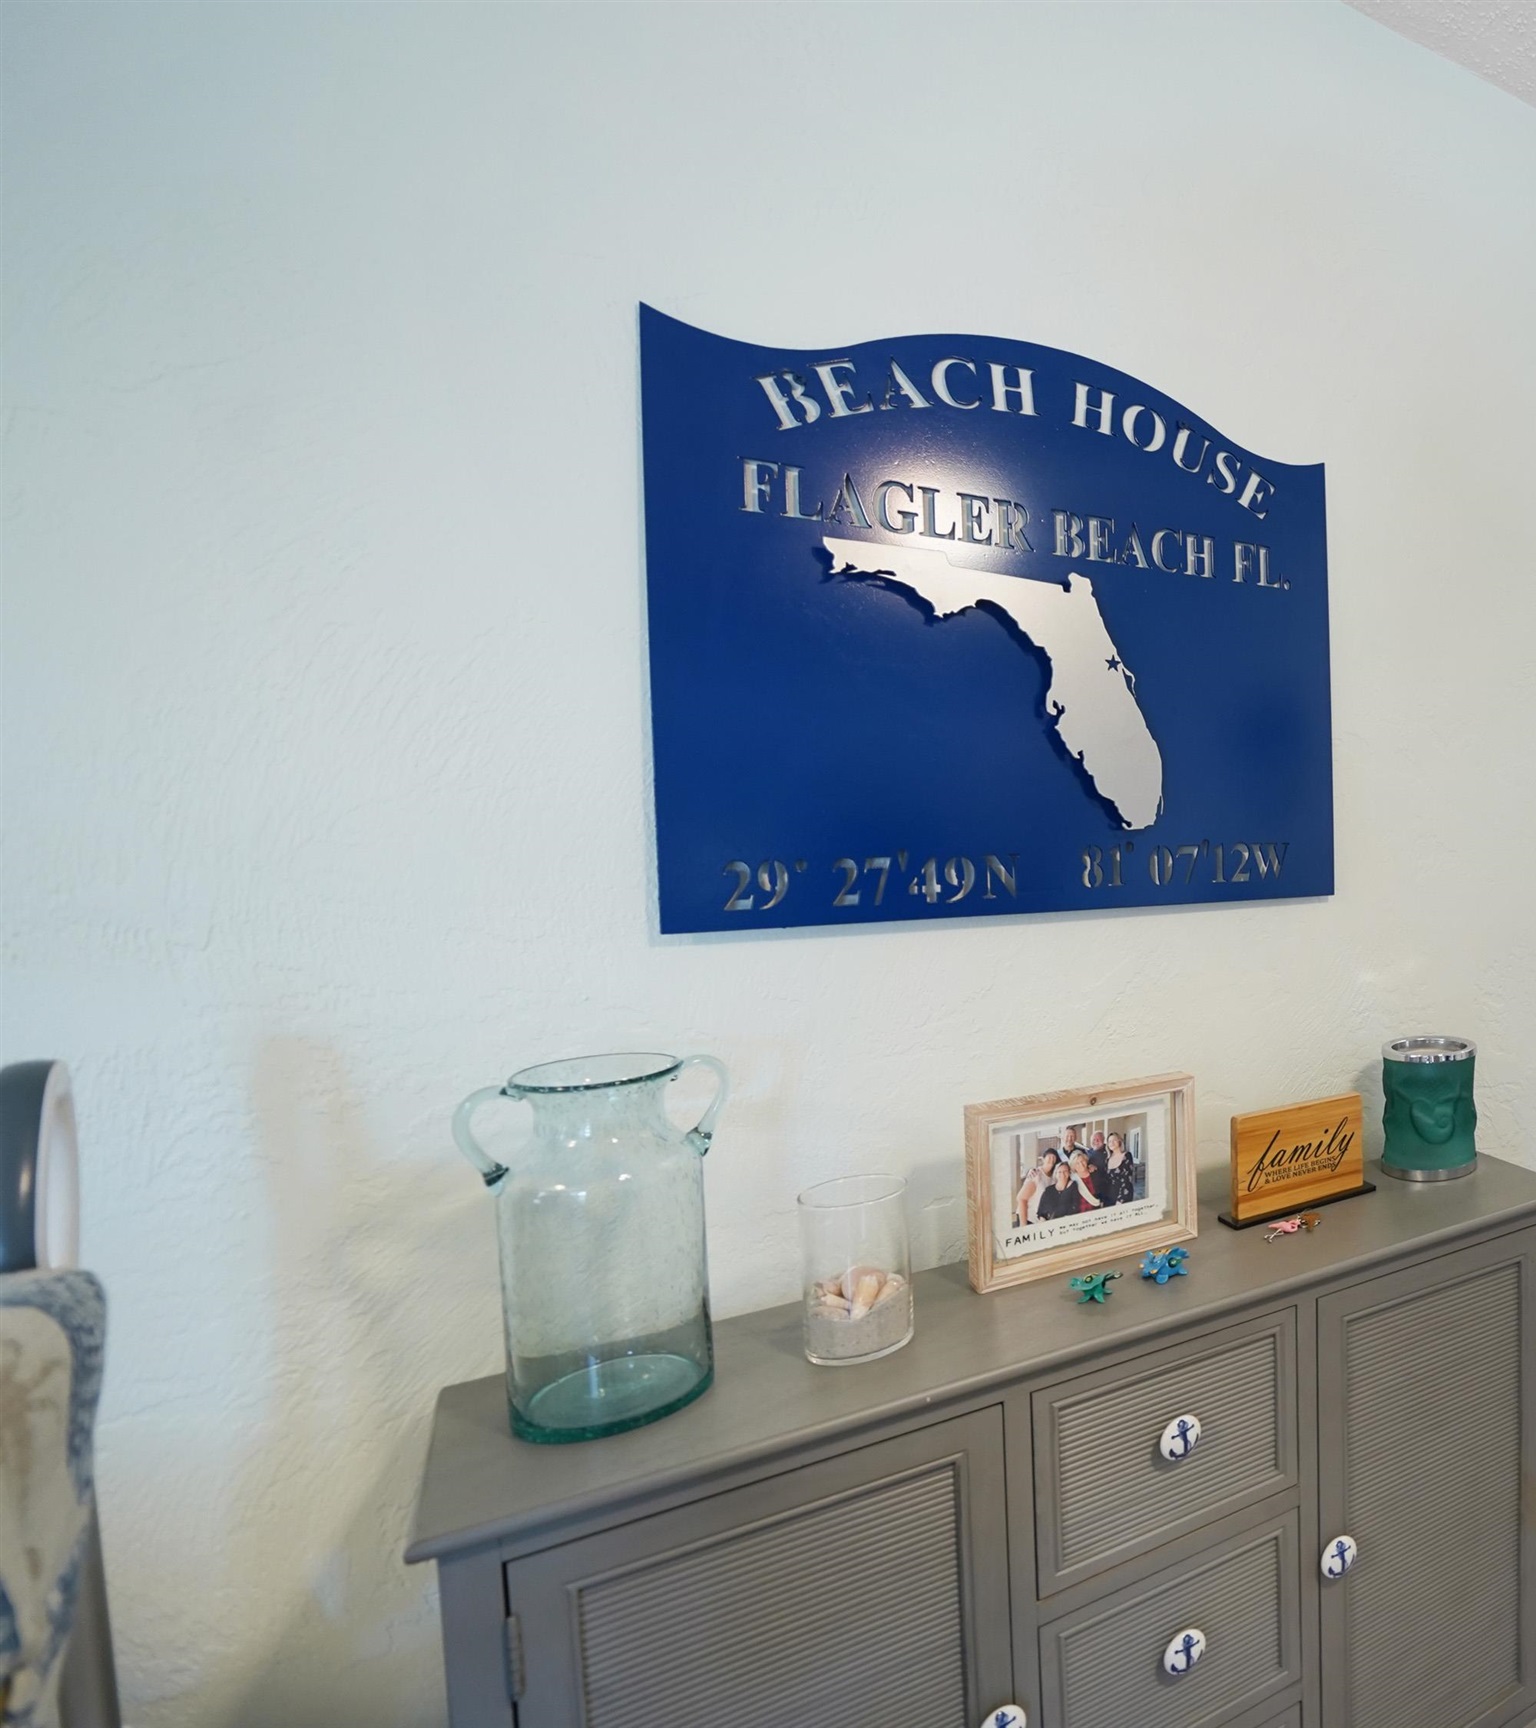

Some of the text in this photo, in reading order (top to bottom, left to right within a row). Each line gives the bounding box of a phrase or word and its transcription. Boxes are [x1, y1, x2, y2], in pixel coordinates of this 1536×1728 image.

[753, 355, 1278, 520] BEACH HOUSE
[737, 455, 1293, 591] FLAGLER BEACH FL.
[1247, 1116, 1355, 1192] family
[1264, 1156, 1336, 1178] WHERE LIFE BEGINS
[1272, 1173, 1291, 1183] LOVE
[1292, 1166, 1317, 1177] NEVER
[1317, 1161, 1336, 1171] ENDS
[1005, 1228, 1055, 1248] FAMILY
